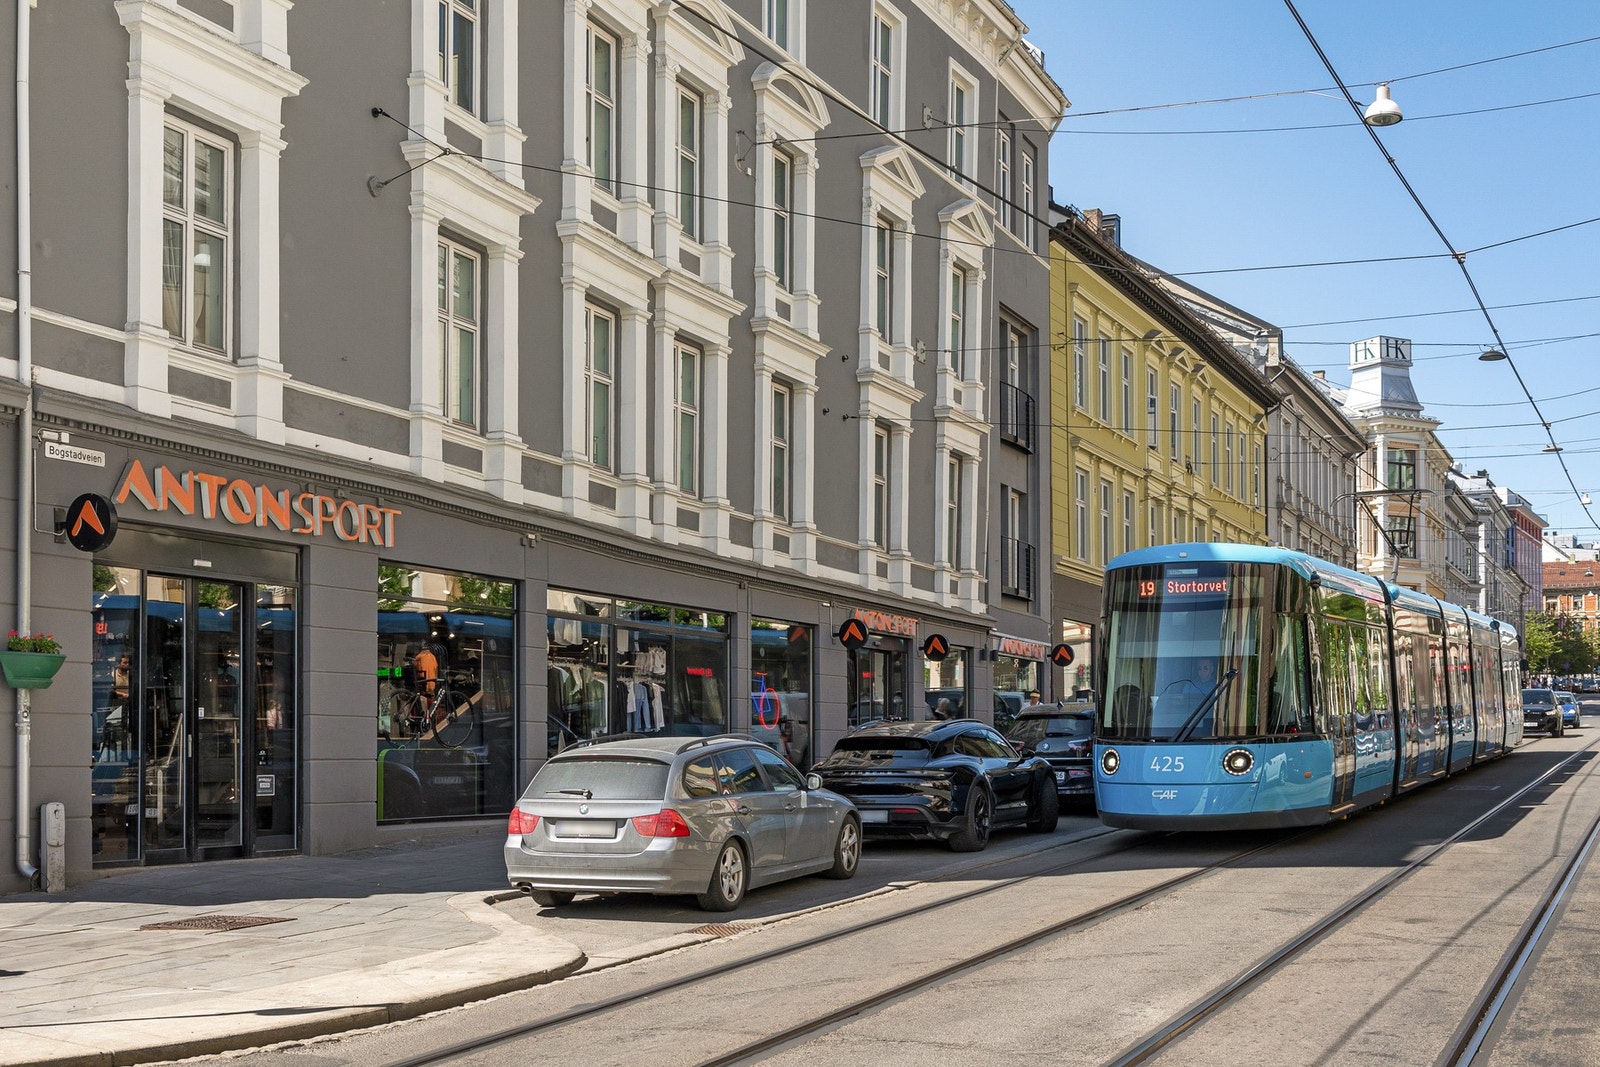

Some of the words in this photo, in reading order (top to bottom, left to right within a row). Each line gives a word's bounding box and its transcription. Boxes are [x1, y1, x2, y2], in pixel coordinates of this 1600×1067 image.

[1385, 338, 1406, 359] HK
[49, 445, 102, 464] Bogstadveien
[1140, 581, 1155, 596] 19
[1167, 579, 1227, 594] Stortorvet
[1150, 756, 1185, 772] 425
[1151, 789, 1178, 800] CAF
